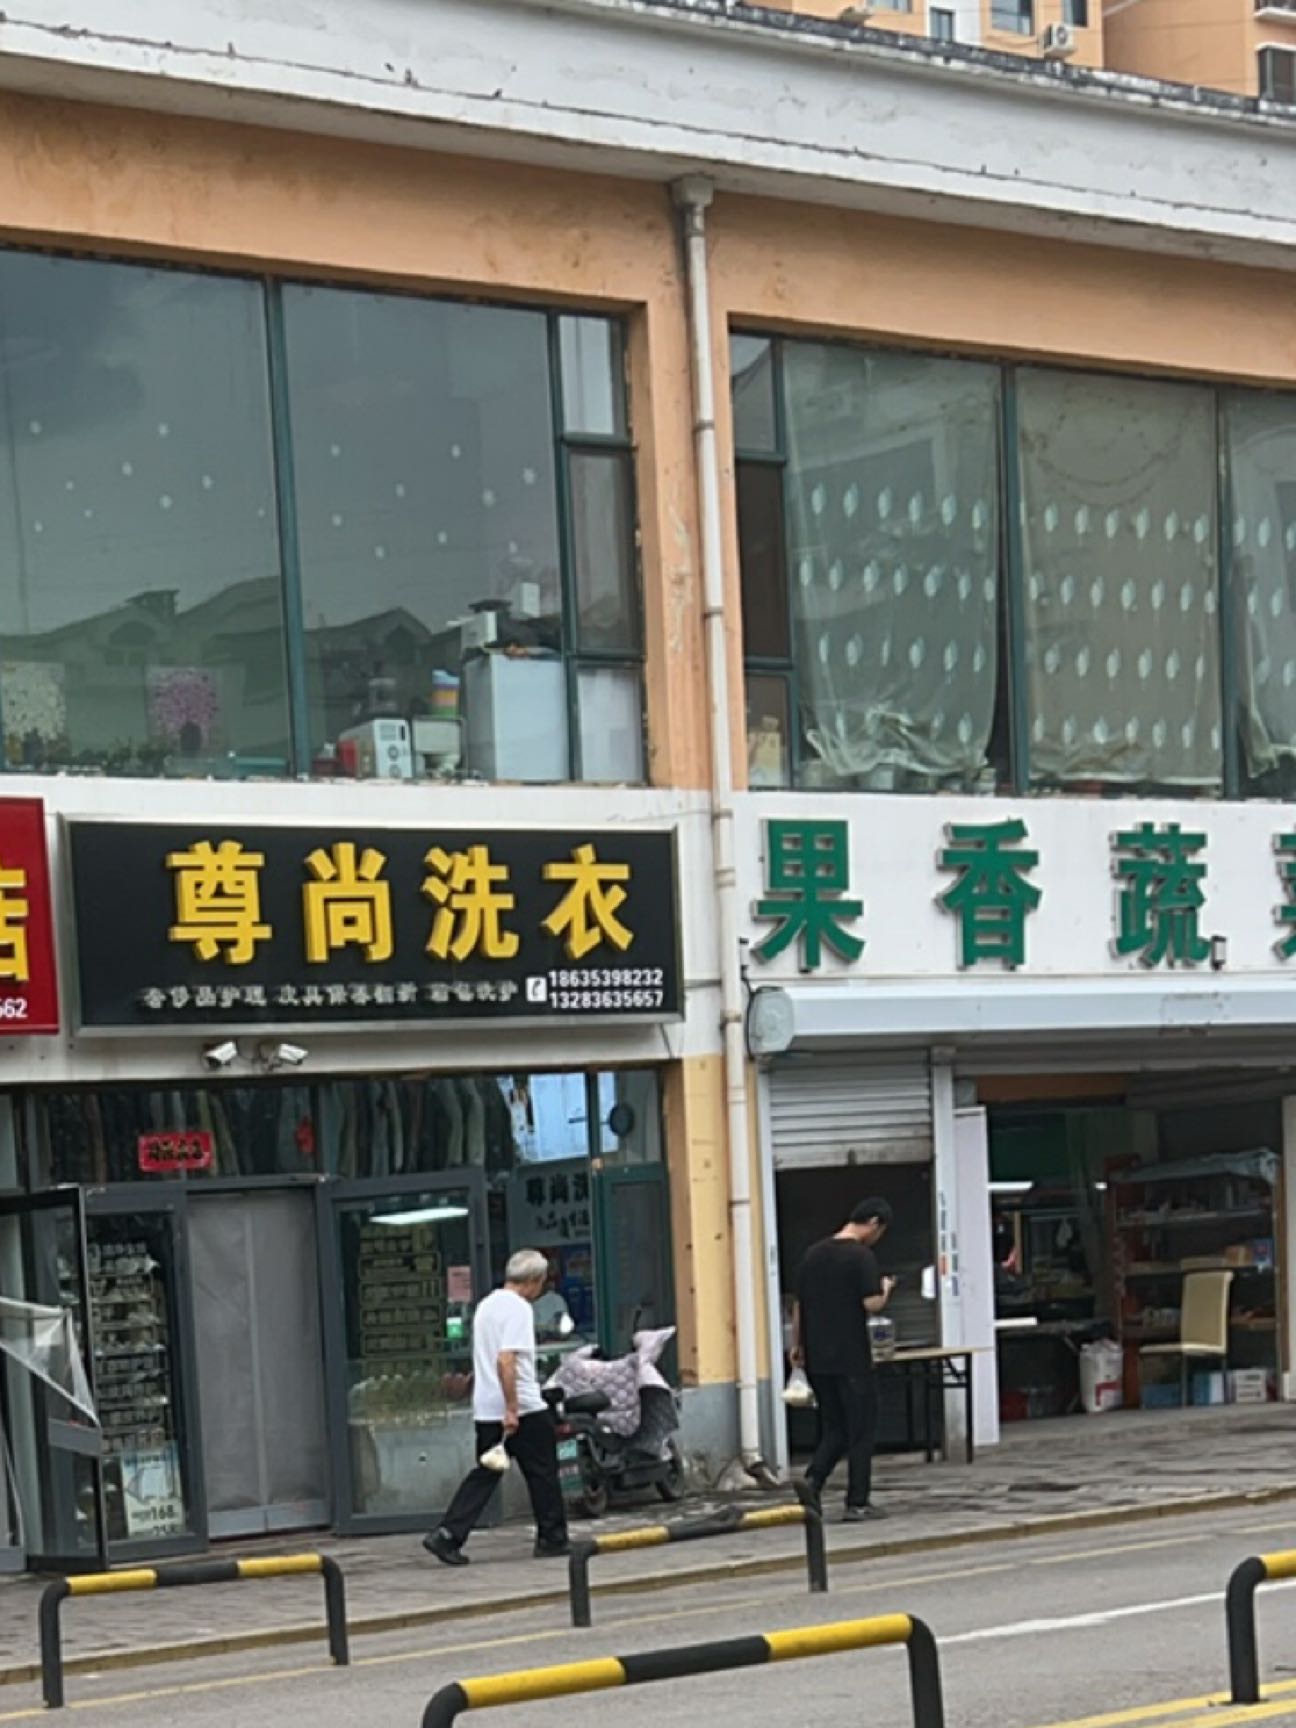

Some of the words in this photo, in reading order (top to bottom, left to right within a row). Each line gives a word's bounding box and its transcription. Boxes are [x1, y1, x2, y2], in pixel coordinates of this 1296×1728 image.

[165, 840, 634, 965] 尊尚洗衣
[752, 816, 1296, 973] 果香蔬
[548, 968, 663, 988] 18635398232
